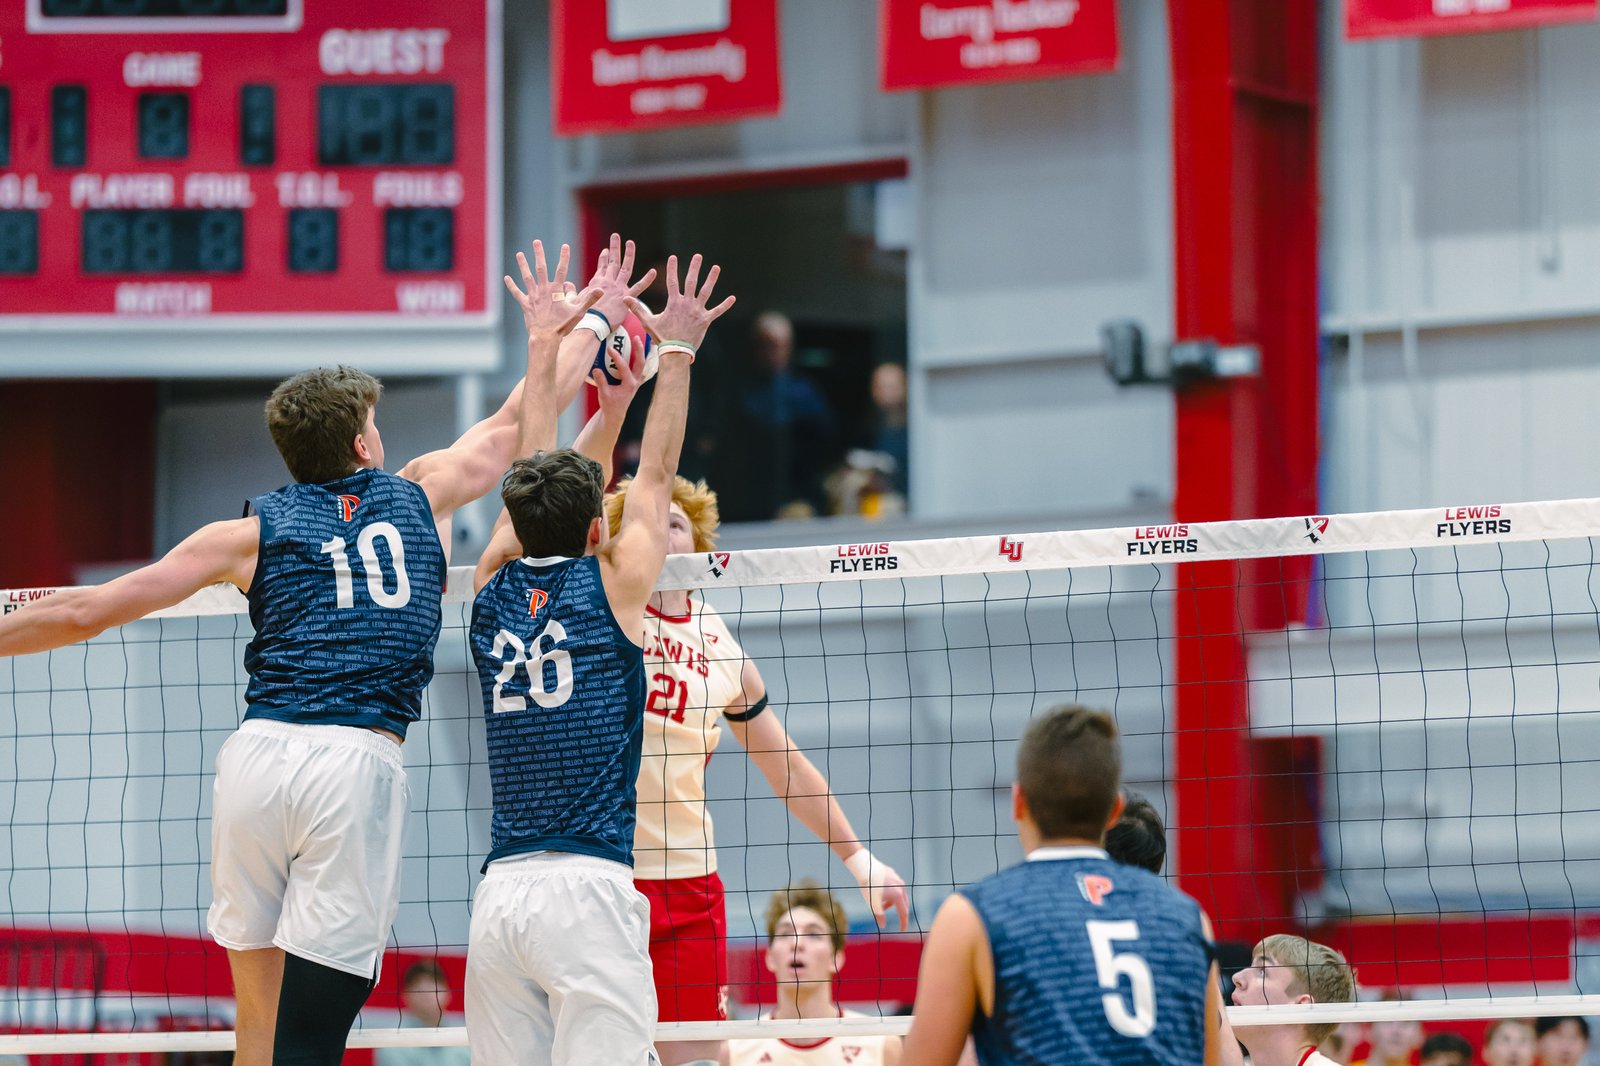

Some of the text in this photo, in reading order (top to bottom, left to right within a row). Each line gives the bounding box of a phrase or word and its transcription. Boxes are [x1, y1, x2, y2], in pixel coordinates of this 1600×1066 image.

[319, 28, 449, 76] GUEST
[123, 52, 202, 87] GAME
[70, 173, 175, 208] PLAYER
[373, 172, 464, 206] FOULS
[115, 282, 212, 314] MATCH
[397, 281, 465, 313] WON
[1437, 519, 1511, 537] FLYERS
[1445, 506, 1501, 520] LEWIS
[1127, 539, 1198, 556] FLYERS
[1135, 525, 1189, 540] LEWIS
[321, 522, 411, 609] 10
[830, 556, 898, 573] FLYERS
[838, 543, 889, 557] LEWIS
[999, 537, 1024, 562] LU
[490, 619, 573, 713] 26
[646, 673, 688, 724] 21
[1086, 920, 1157, 1038] 5
